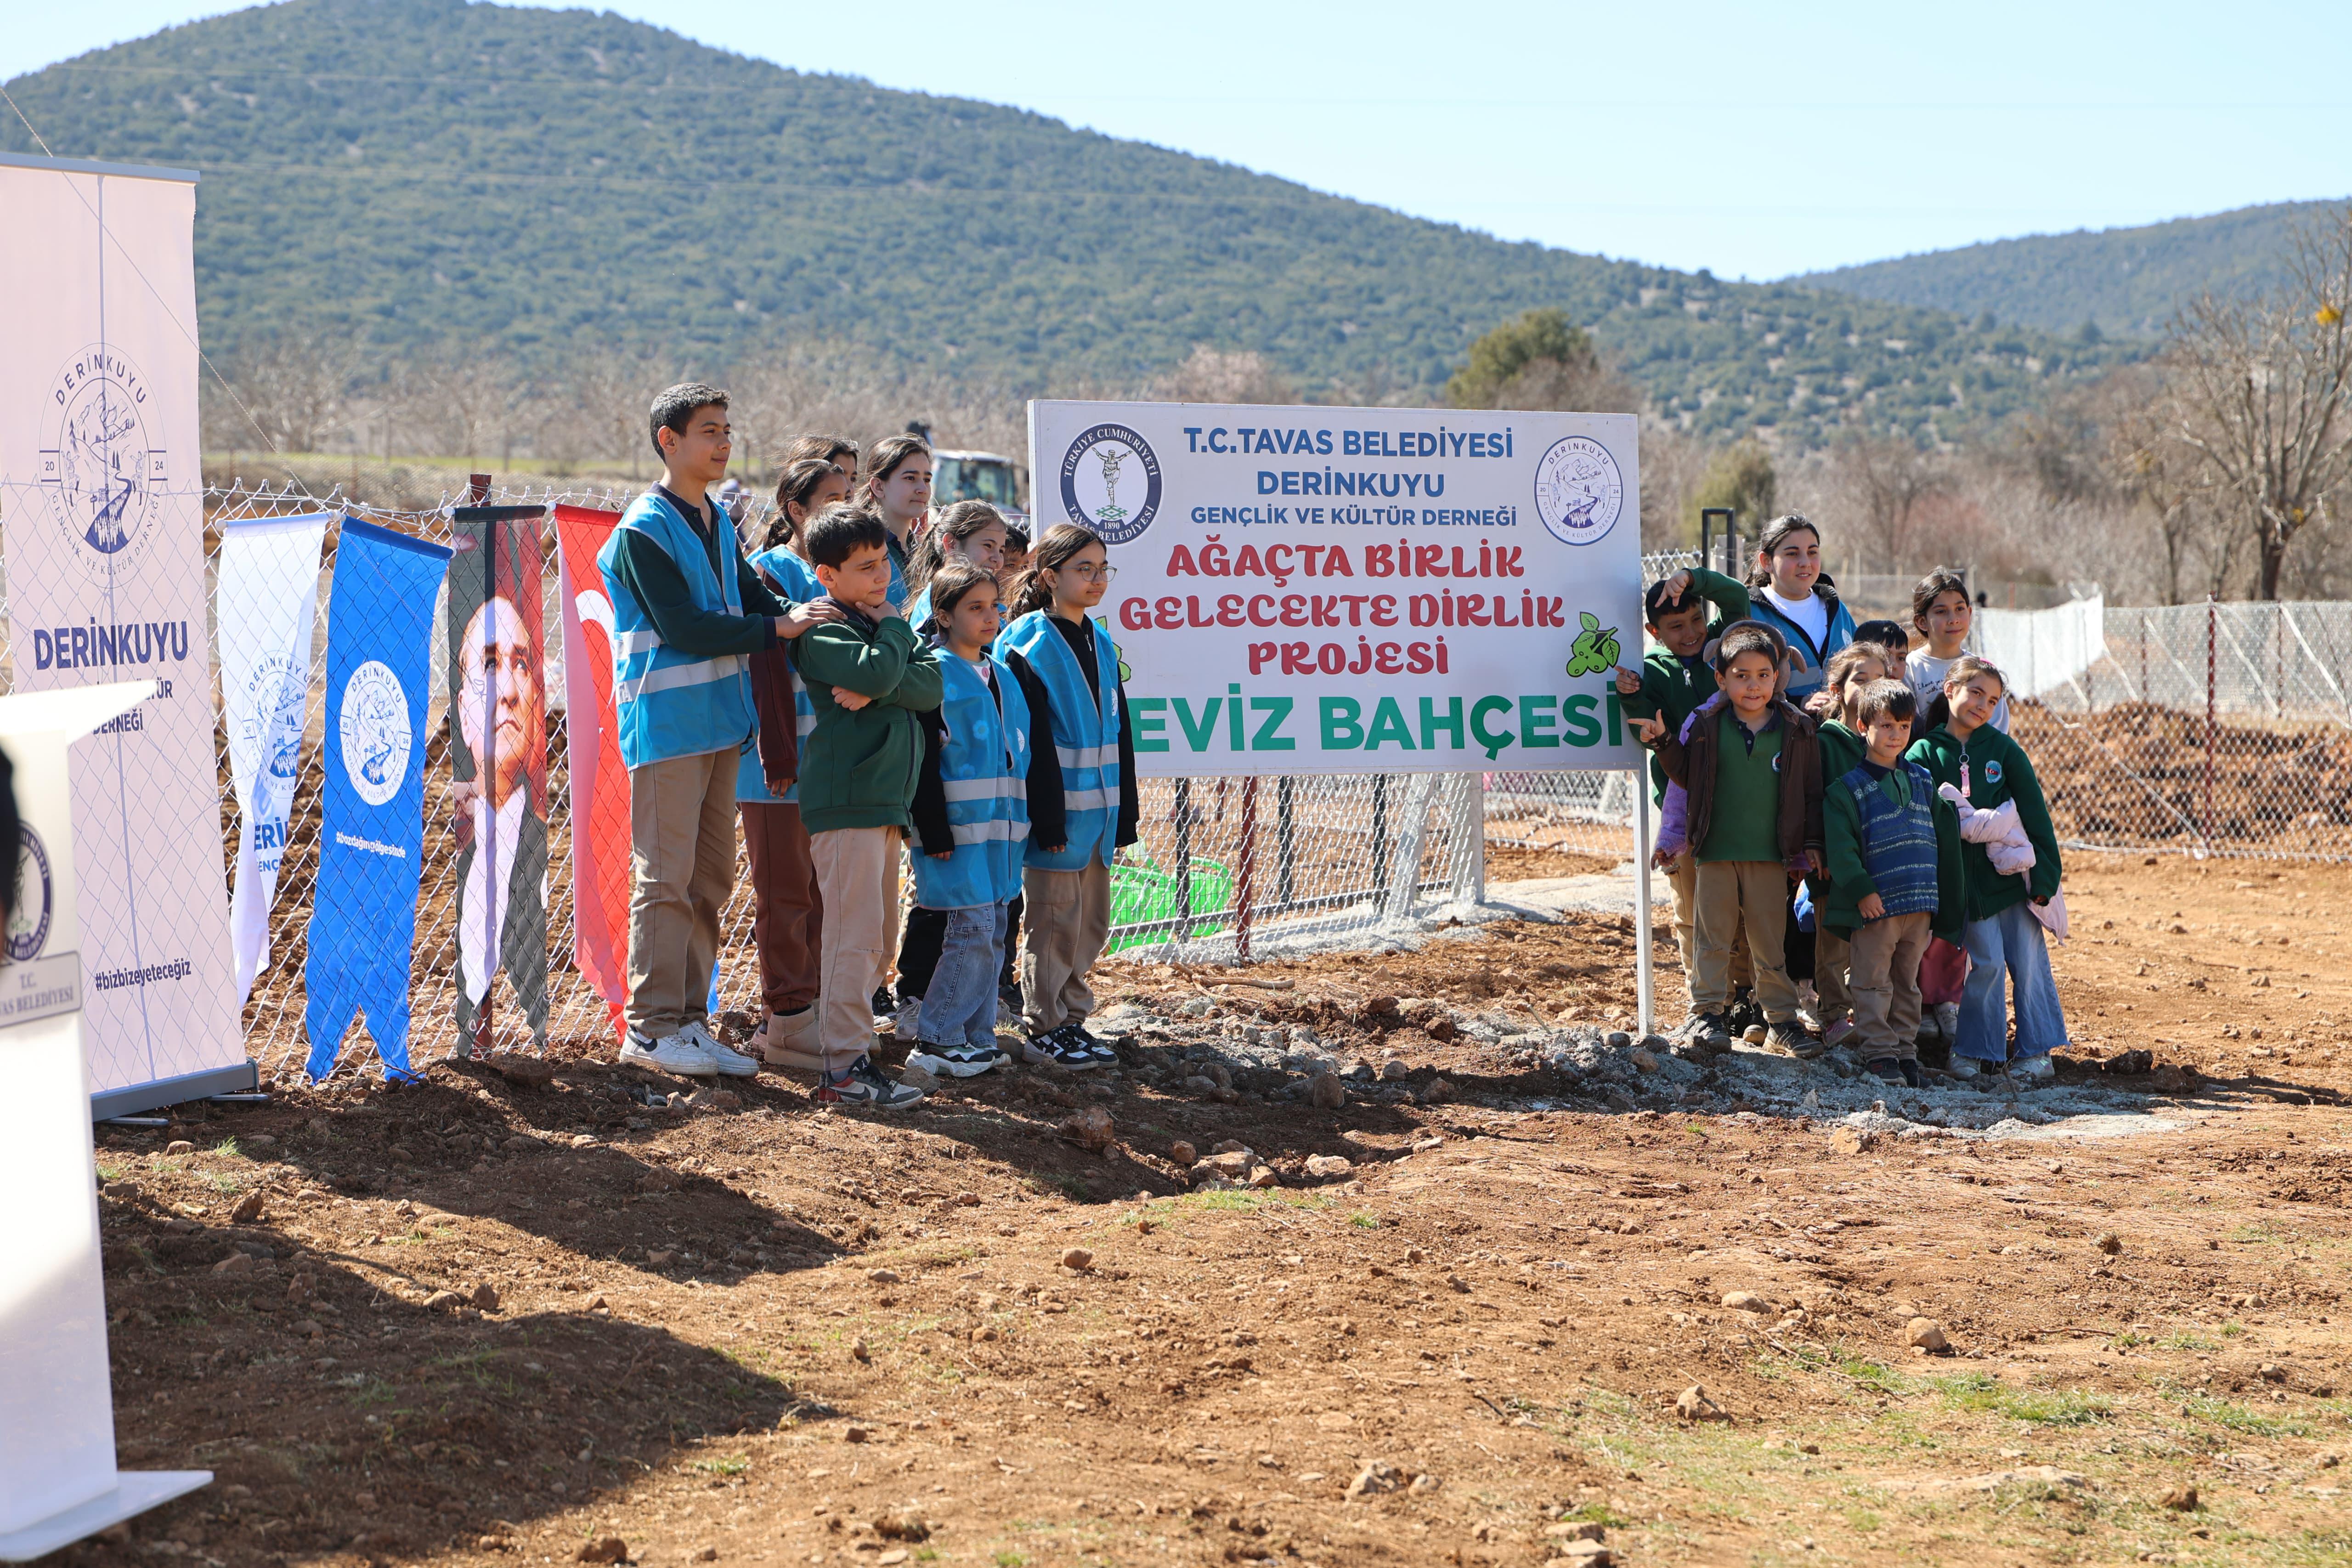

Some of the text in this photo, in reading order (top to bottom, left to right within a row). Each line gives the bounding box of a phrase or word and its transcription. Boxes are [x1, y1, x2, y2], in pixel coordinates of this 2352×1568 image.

[56, 353, 146, 405] DERİNKUYU
[1064, 428, 1159, 477] TÜRKİYE CUMHURİYETİ
[1344, 426, 1513, 458] BELEDİYESİ
[1549, 442, 1609, 465] DERİNKUYU
[45, 461, 54, 471] 20
[155, 461, 164, 470] 24
[1258, 466, 1445, 498] DERİNKUYU
[1098, 505, 1154, 541] BELEDİYESİ
[1192, 504, 1517, 526] GENÇLİK VE KÜLTÜR DERNEĞİ
[87, 557, 96, 571] VE
[1167, 534, 1524, 588] AĞAÇTA BİRLİK
[1120, 589, 1565, 631] GELECEKTE DİRLİK
[34, 617, 188, 670] DERİNKUYU
[1249, 636, 1448, 675] PROJESİ
[352, 665, 401, 703] DERİNKUYU
[1126, 680, 1622, 760] EVİZ BAHÇESİ
[96, 957, 192, 991] #bizbizeyeteceğiz
